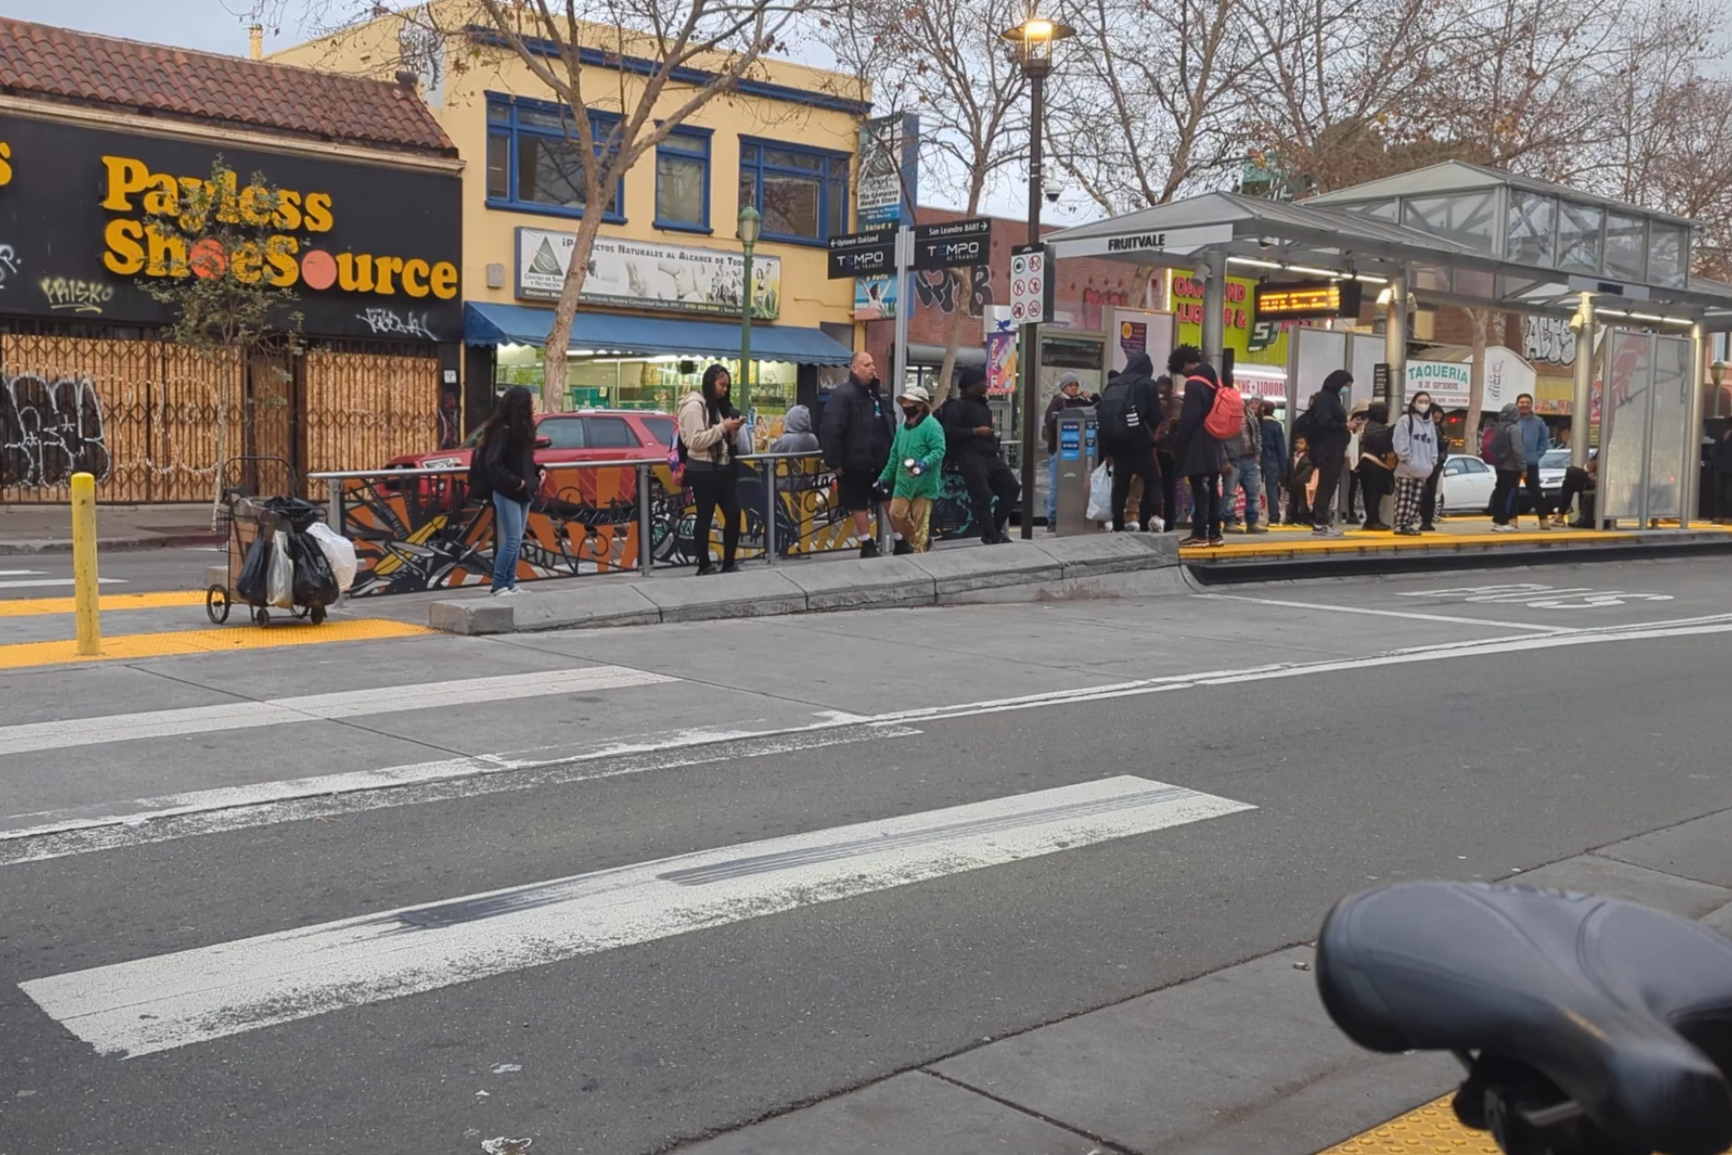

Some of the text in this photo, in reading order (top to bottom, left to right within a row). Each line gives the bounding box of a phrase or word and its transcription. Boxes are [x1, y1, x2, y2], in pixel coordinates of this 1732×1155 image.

[102, 155, 334, 232] Payless
[865, 222, 886, 232] Salud
[929, 223, 980, 236] San Leandro BART
[857, 234, 879, 244] Oakland
[1108, 234, 1165, 251] FRUITVALE
[927, 241, 980, 257] TEMPO
[103, 218, 459, 300] ShoeSource
[836, 251, 884, 267] TEMPO
[1178, 303, 1247, 328] LIQR &
[1408, 365, 1468, 384] TAQUERIA
[1257, 381, 1284, 397] LIQUOR
